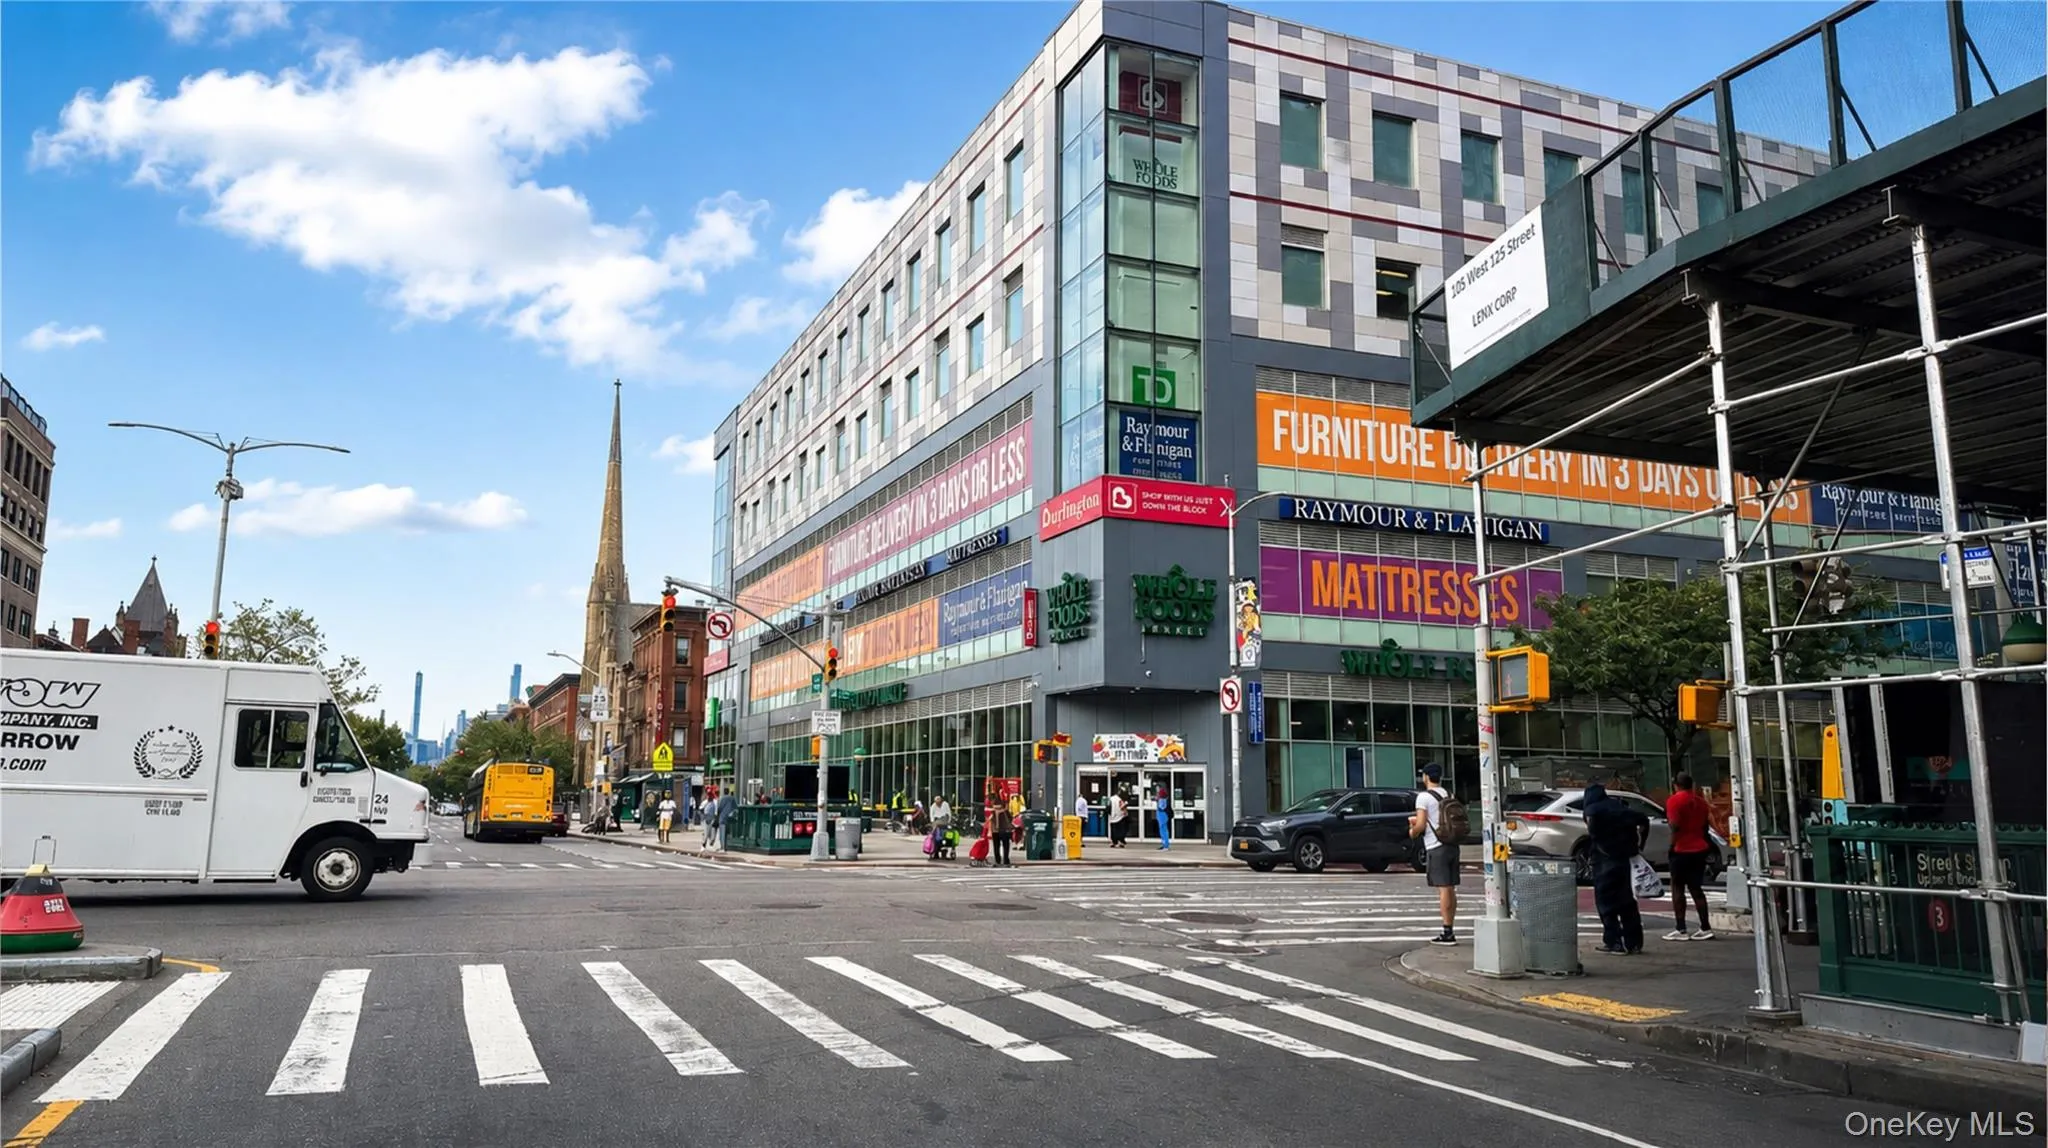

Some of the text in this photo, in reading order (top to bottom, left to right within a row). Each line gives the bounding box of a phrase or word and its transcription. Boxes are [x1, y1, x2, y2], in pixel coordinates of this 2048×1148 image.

[1132, 158, 1178, 178] WHOLE
[1136, 171, 1178, 189] FOODS
[1451, 223, 1536, 299] 105 West 125 Street
[1472, 286, 1518, 328] LENX CORP
[1137, 374, 1172, 404] TD
[1126, 416, 1190, 440] Raymour
[1122, 435, 1133, 452] &
[1273, 409, 1436, 468] FURNITURE
[1582, 454, 1608, 488] IN
[1615, 458, 1630, 490] 3
[1638, 461, 1700, 498] DAYS
[929, 487, 938, 524] 3
[939, 469, 969, 520] DAYS
[971, 457, 988, 503] OR
[991, 436, 1026, 493] LESS
[1294, 498, 1409, 528] RAYMOUR
[1414, 511, 1428, 530] &
[1131, 574, 1217, 600] WHOLE
[1134, 598, 1215, 622] FOODS
[1341, 649, 1436, 678] WHOLE
[60, 716, 92, 727] INC.
[0, 732, 80, 750] RROW
[375, 794, 389, 804] 24
